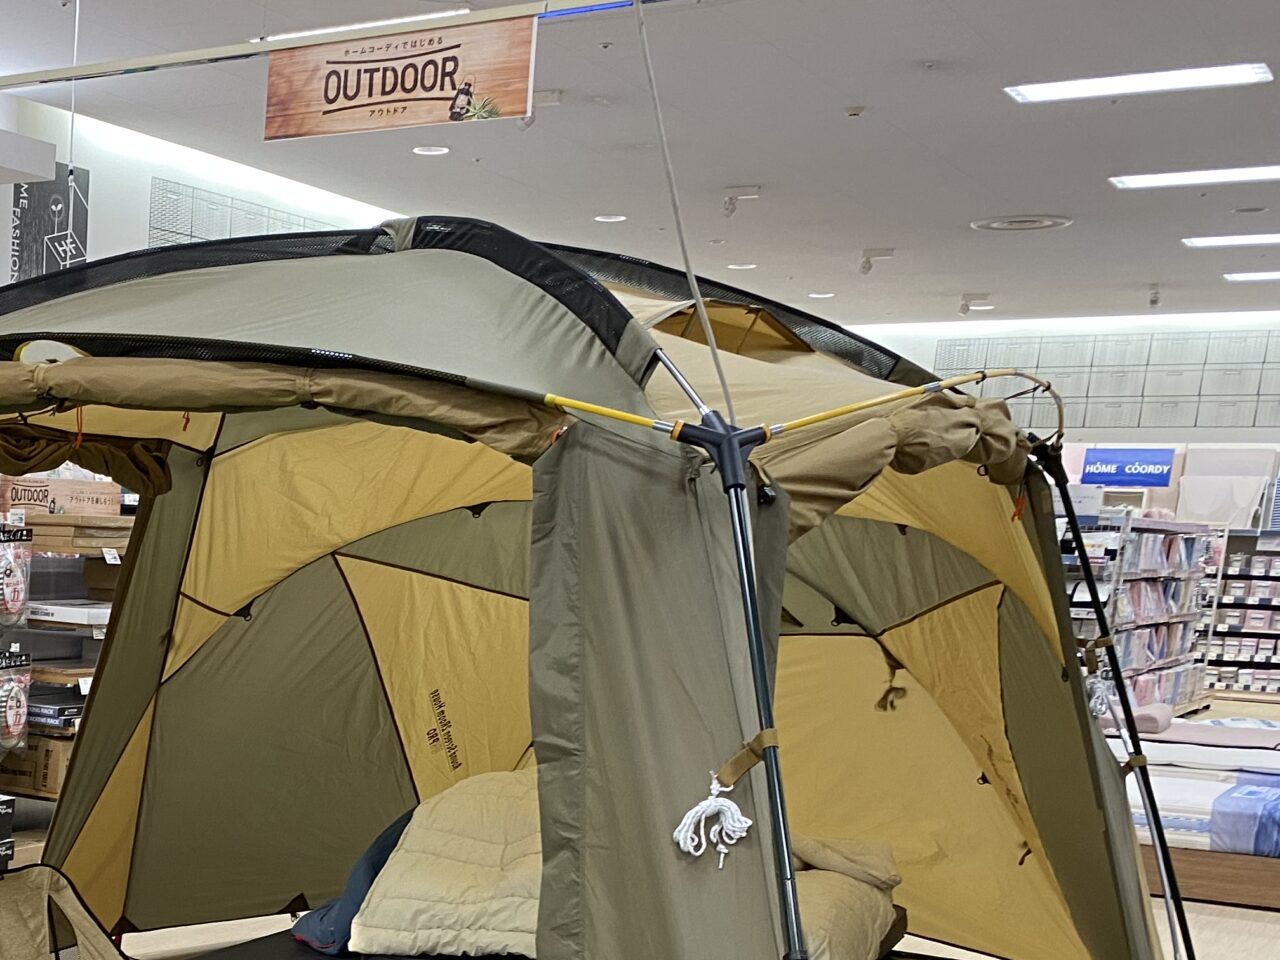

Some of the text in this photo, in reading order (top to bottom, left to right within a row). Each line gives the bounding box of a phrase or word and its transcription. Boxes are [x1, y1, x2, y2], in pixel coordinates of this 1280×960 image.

[344, 36, 444, 57] ホームコーディではじめる
[323, 55, 460, 105] OUTDOOR
[369, 106, 407, 118] アウトドア
[9, 208, 21, 283] FASHION
[11, 486, 49, 504] OUTDOOR
